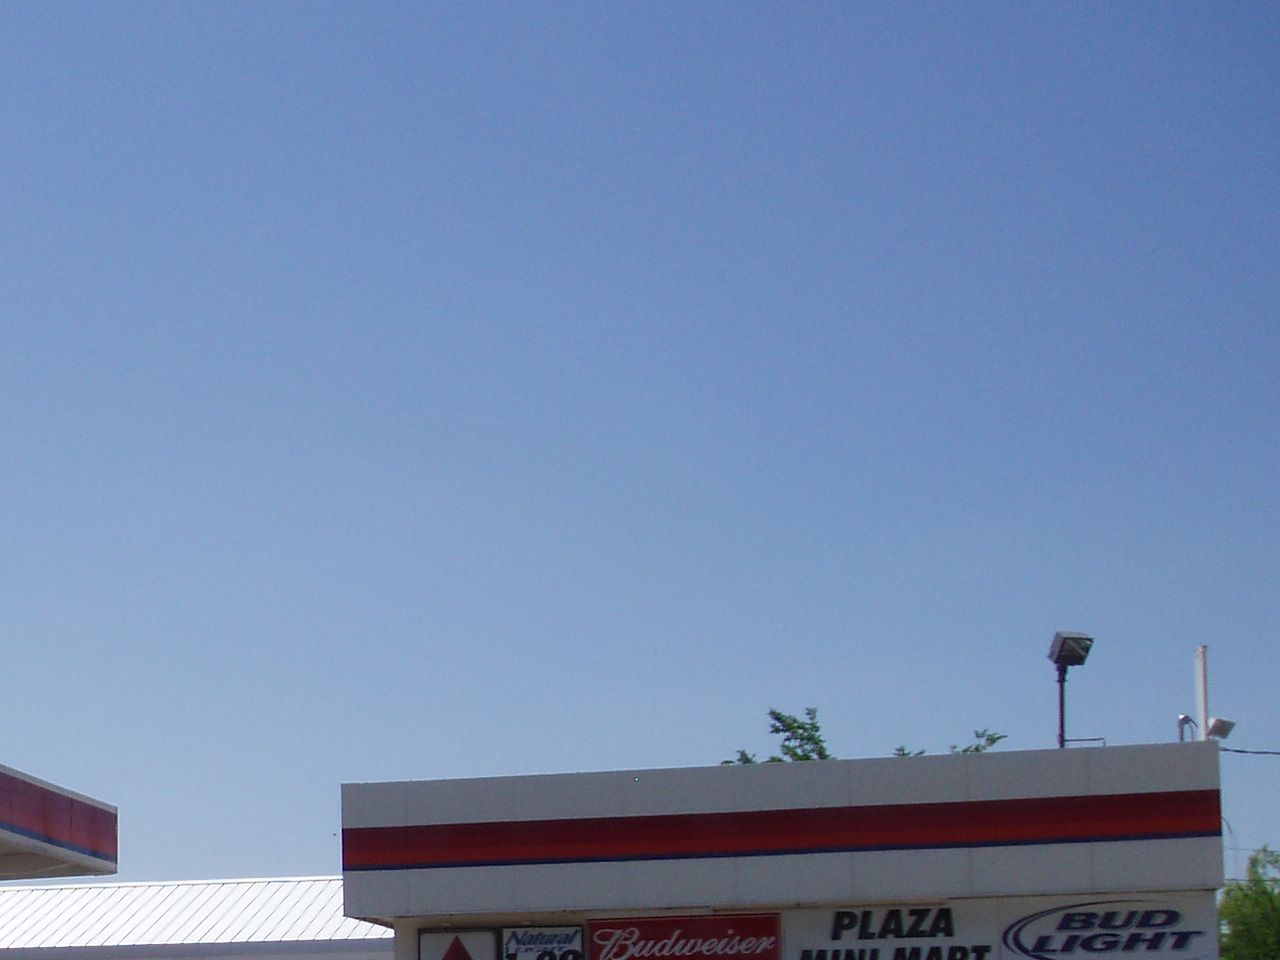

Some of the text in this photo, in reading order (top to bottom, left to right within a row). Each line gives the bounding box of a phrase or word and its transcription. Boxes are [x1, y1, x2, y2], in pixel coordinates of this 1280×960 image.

[831, 907, 955, 941] PLAZA
[1056, 909, 1181, 931] BUD
[506, 929, 579, 949] Natural
[1030, 930, 1206, 953] LIGHT
